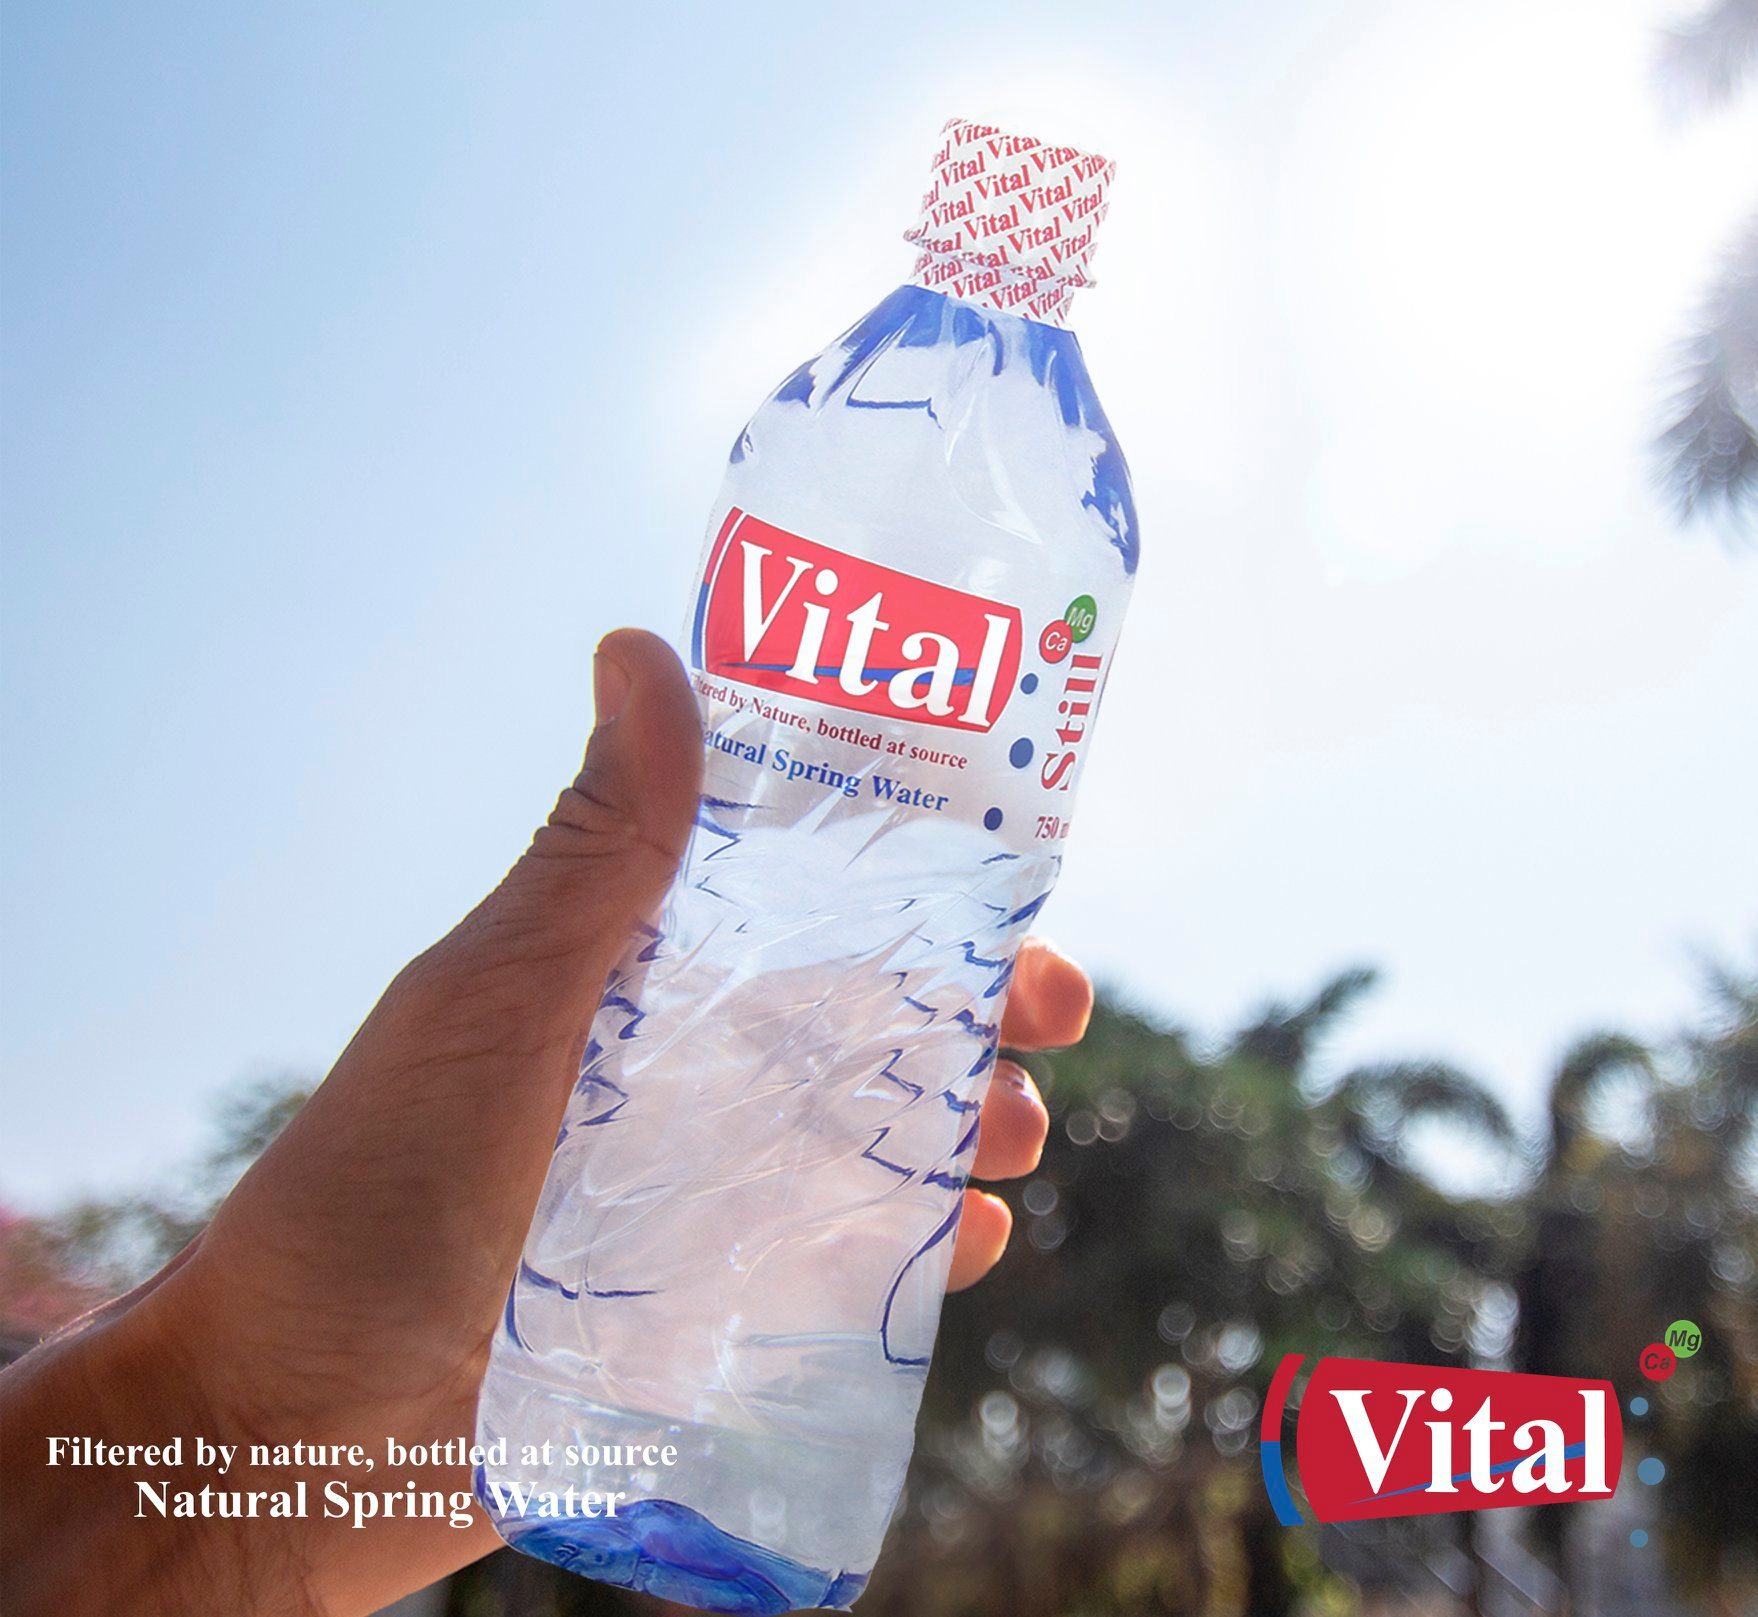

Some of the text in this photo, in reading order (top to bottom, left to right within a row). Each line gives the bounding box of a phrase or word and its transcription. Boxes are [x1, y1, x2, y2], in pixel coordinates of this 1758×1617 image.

[941, 151, 985, 187] Vital
[974, 164, 1031, 199] Vital
[931, 191, 975, 228] Vital
[1019, 176, 1073, 213] Vital
[1062, 184, 1103, 223] Vital
[964, 204, 1020, 240] Vital
[1007, 216, 1062, 254] Vital
[919, 232, 962, 254] ital
[1049, 225, 1092, 264] Vital
[952, 268, 1002, 298] Vital
[990, 279, 1038, 310] Vital
[740, 540, 1011, 727] Vital
[1065, 606, 1095, 634] Mg
[1045, 631, 1069, 651] Ca
[729, 689, 748, 713] by
[750, 697, 812, 733] Nature,
[817, 718, 883, 750] bottled
[887, 740, 906, 756] at
[909, 746, 968, 769] source
[1041, 654, 1103, 791] Still
[704, 729, 949, 811] atural Spring Water
[1034, 816, 1060, 839] 750
